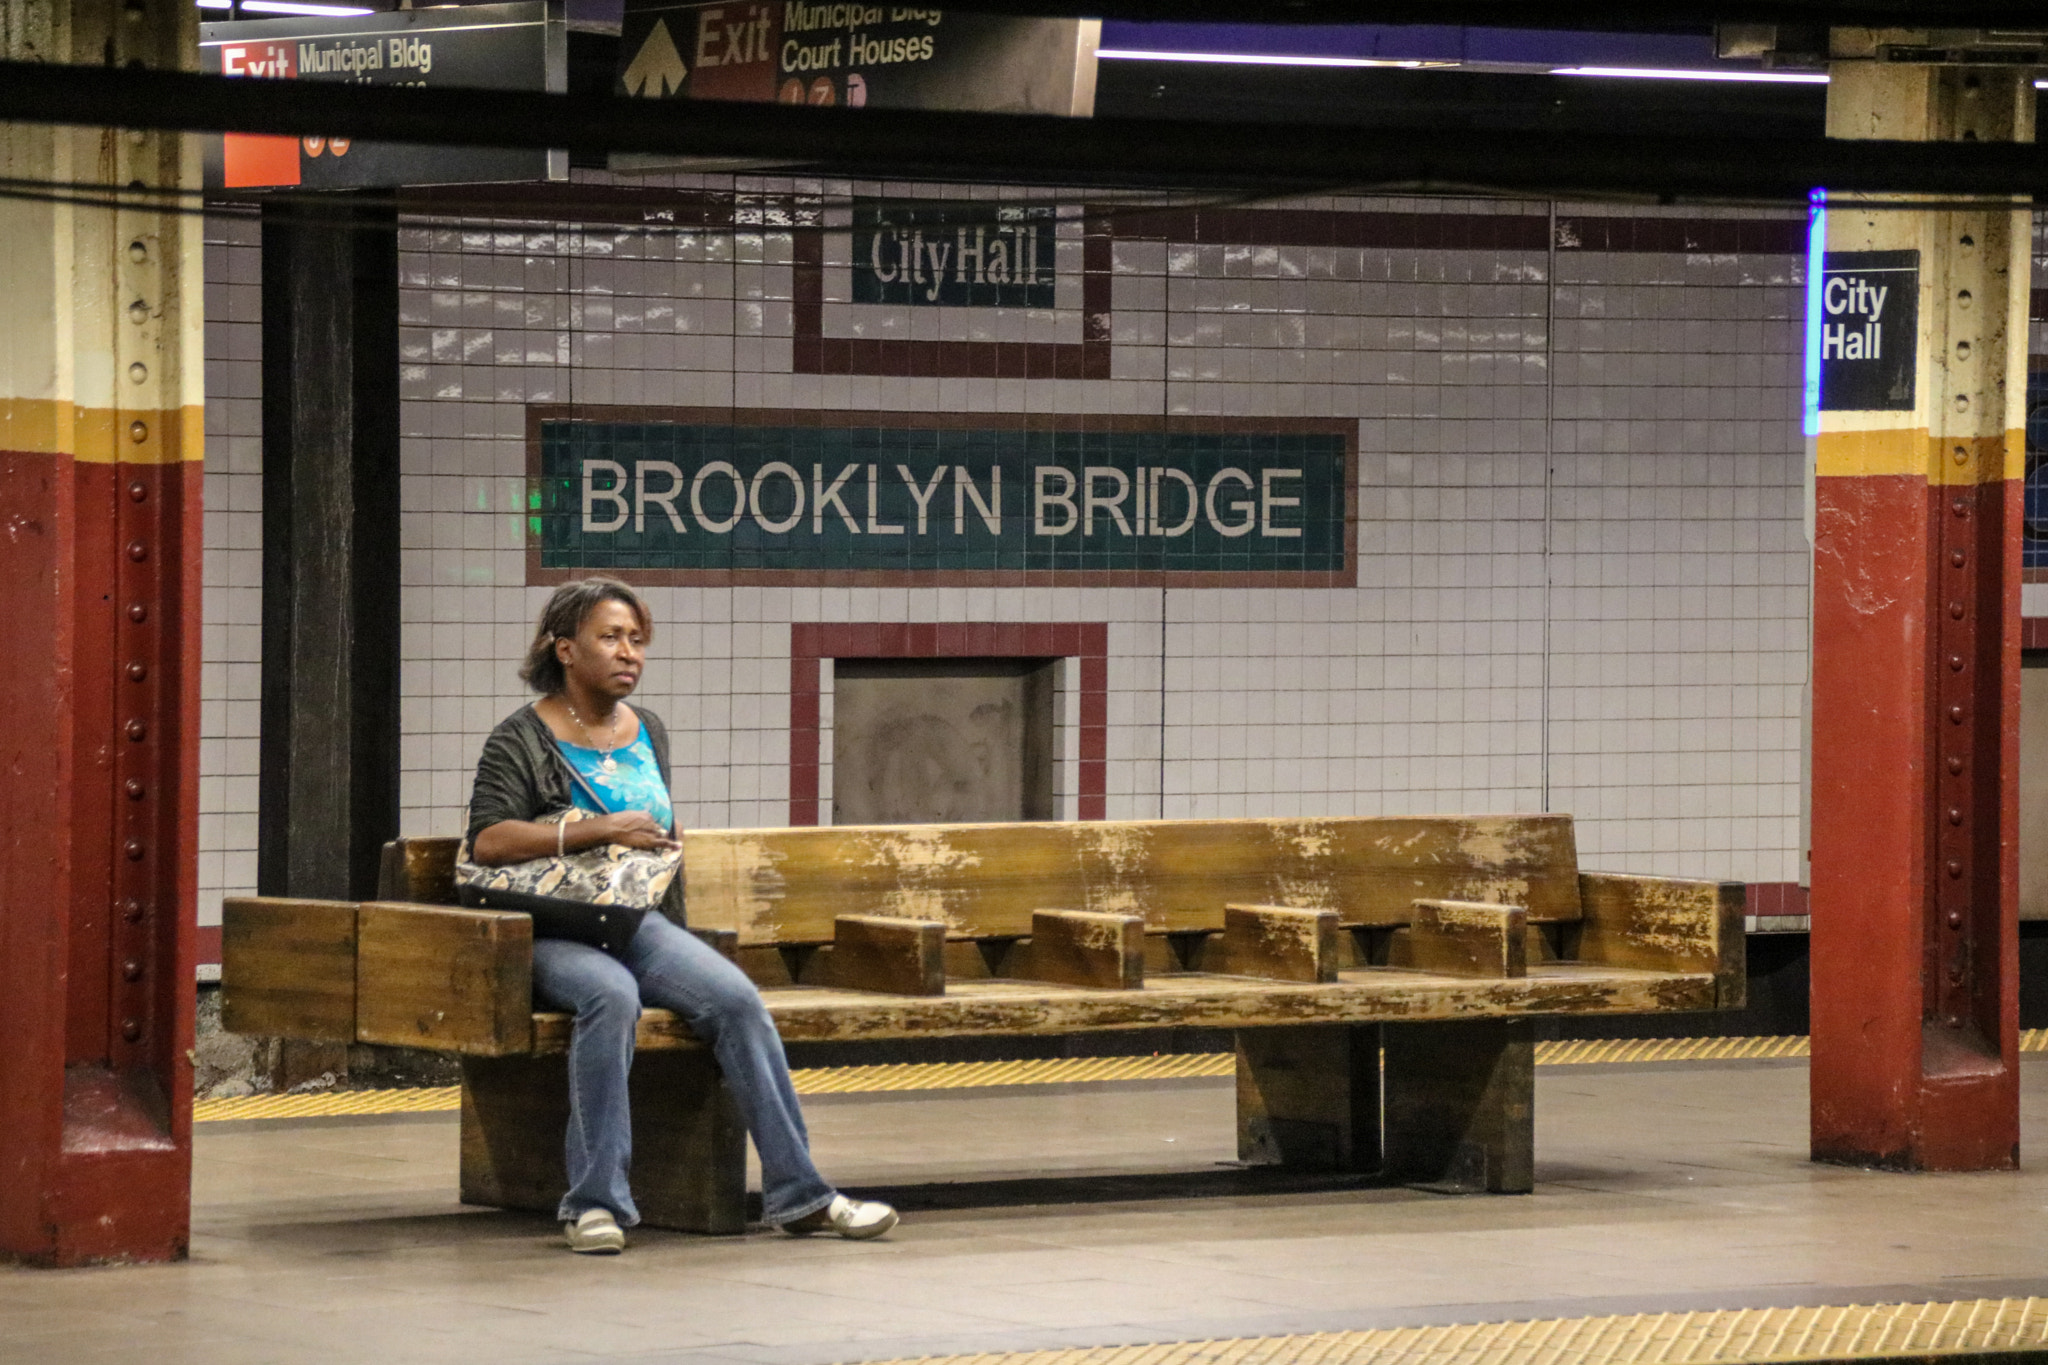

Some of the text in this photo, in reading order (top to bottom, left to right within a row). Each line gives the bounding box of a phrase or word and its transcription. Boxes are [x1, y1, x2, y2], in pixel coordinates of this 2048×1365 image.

[299, 38, 431, 77] Municipal Bldg
[696, 5, 771, 67] Exit
[782, 33, 934, 72] Court Houses
[871, 221, 1039, 301] City Hall
[1824, 277, 1888, 322] City
[1822, 323, 1882, 360] Hall
[582, 459, 1302, 537] BROOKLYN BRIDGE
